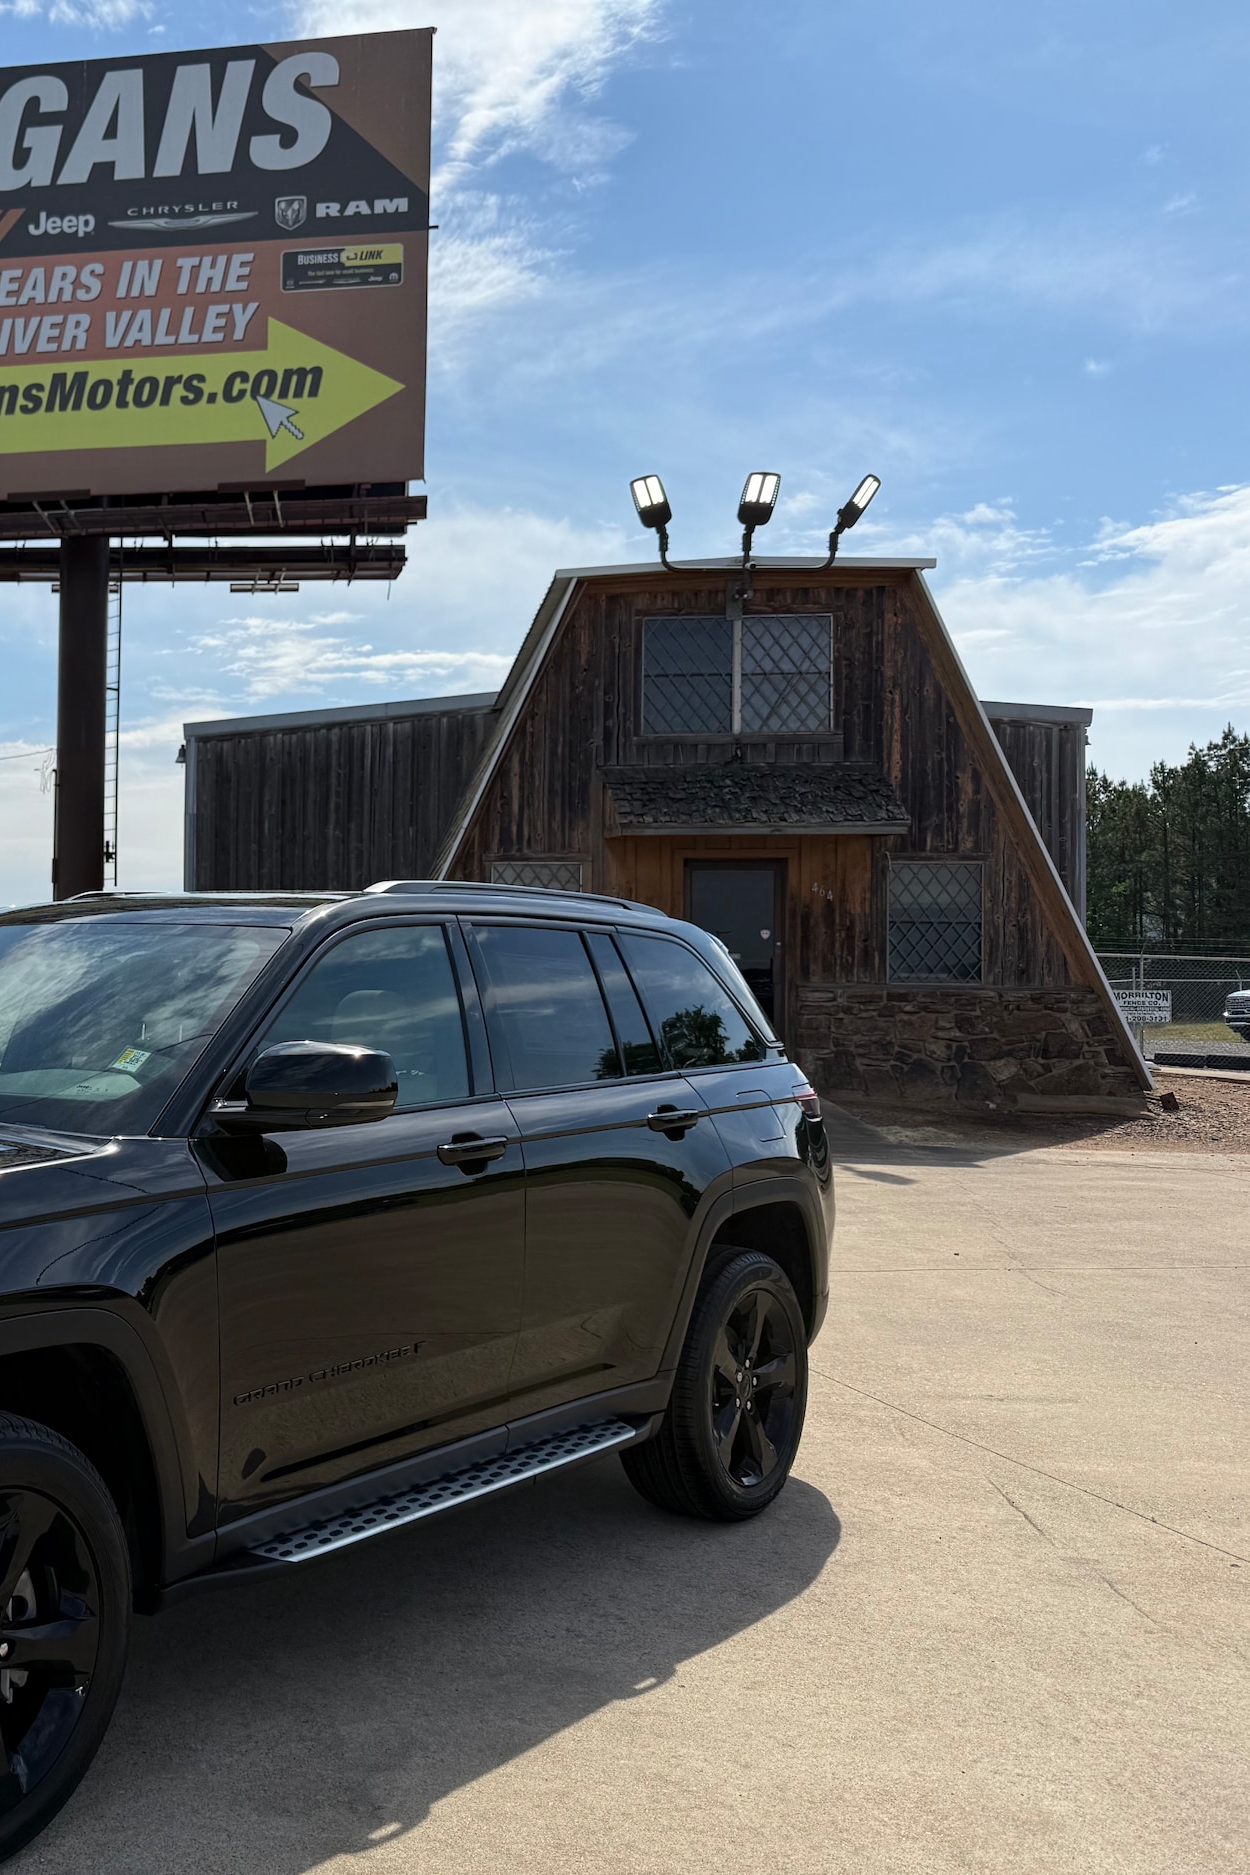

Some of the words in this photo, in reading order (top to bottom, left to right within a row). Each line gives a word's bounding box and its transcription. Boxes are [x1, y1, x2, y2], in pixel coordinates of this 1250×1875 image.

[28, 211, 96, 238] Jeep
[126, 200, 239, 217] CHRYSLER
[315, 197, 409, 219] RAM
[297, 252, 339, 265] BUSINESS
[359, 250, 384, 261] LINK
[115, 259, 162, 300] IN
[175, 253, 255, 296] THE
[104, 301, 261, 350] VALLEY
[811, 882, 834, 901] 464
[233, 1375, 305, 1407] GRAND
